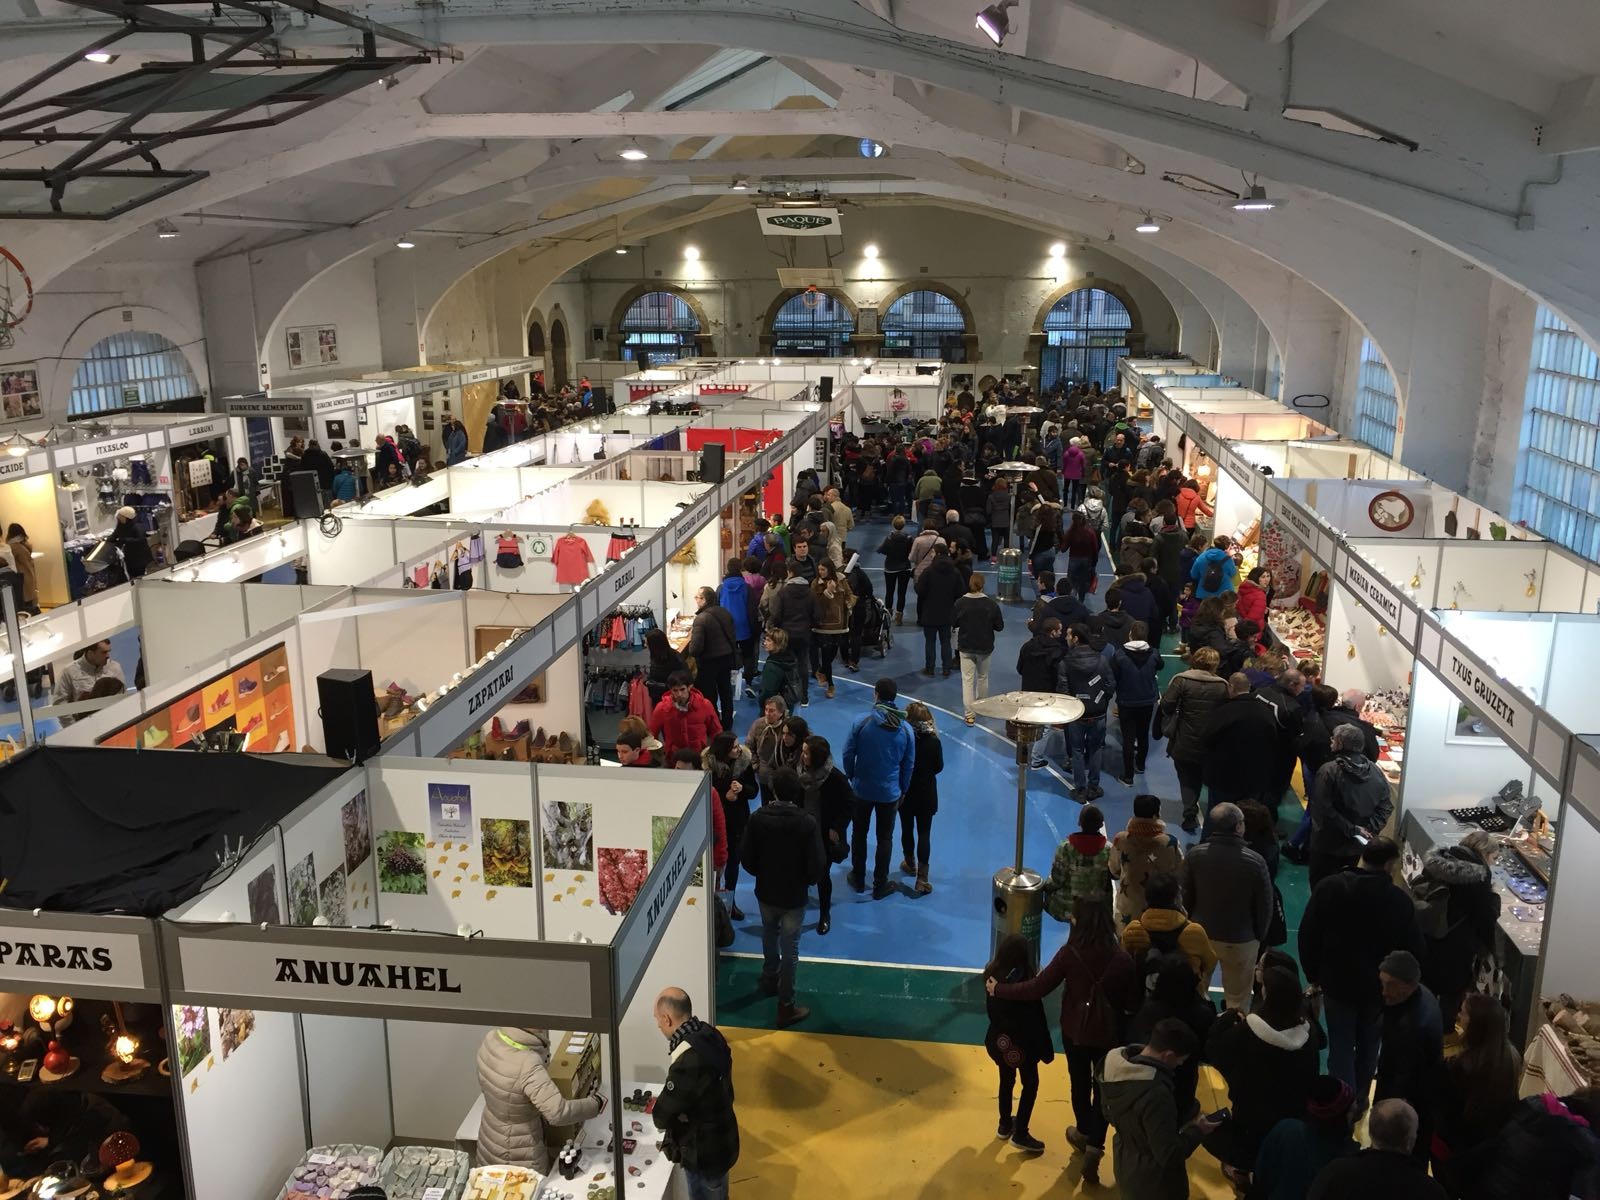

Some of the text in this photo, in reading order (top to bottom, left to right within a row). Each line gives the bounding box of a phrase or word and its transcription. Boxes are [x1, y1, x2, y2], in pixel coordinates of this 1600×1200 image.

[95, 441, 129, 455] ITXASLOO
[615, 568, 635, 593] ERABILI
[1350, 565, 1398, 620] MARIAN CERAMICA
[468, 665, 514, 716] ZAPATARI
[1452, 656, 1515, 728] TXUS GRUZETA
[646, 846, 689, 936] ANUAHEL
[0, 941, 112, 972] PARAS
[275, 957, 462, 994] ANUAHEL
